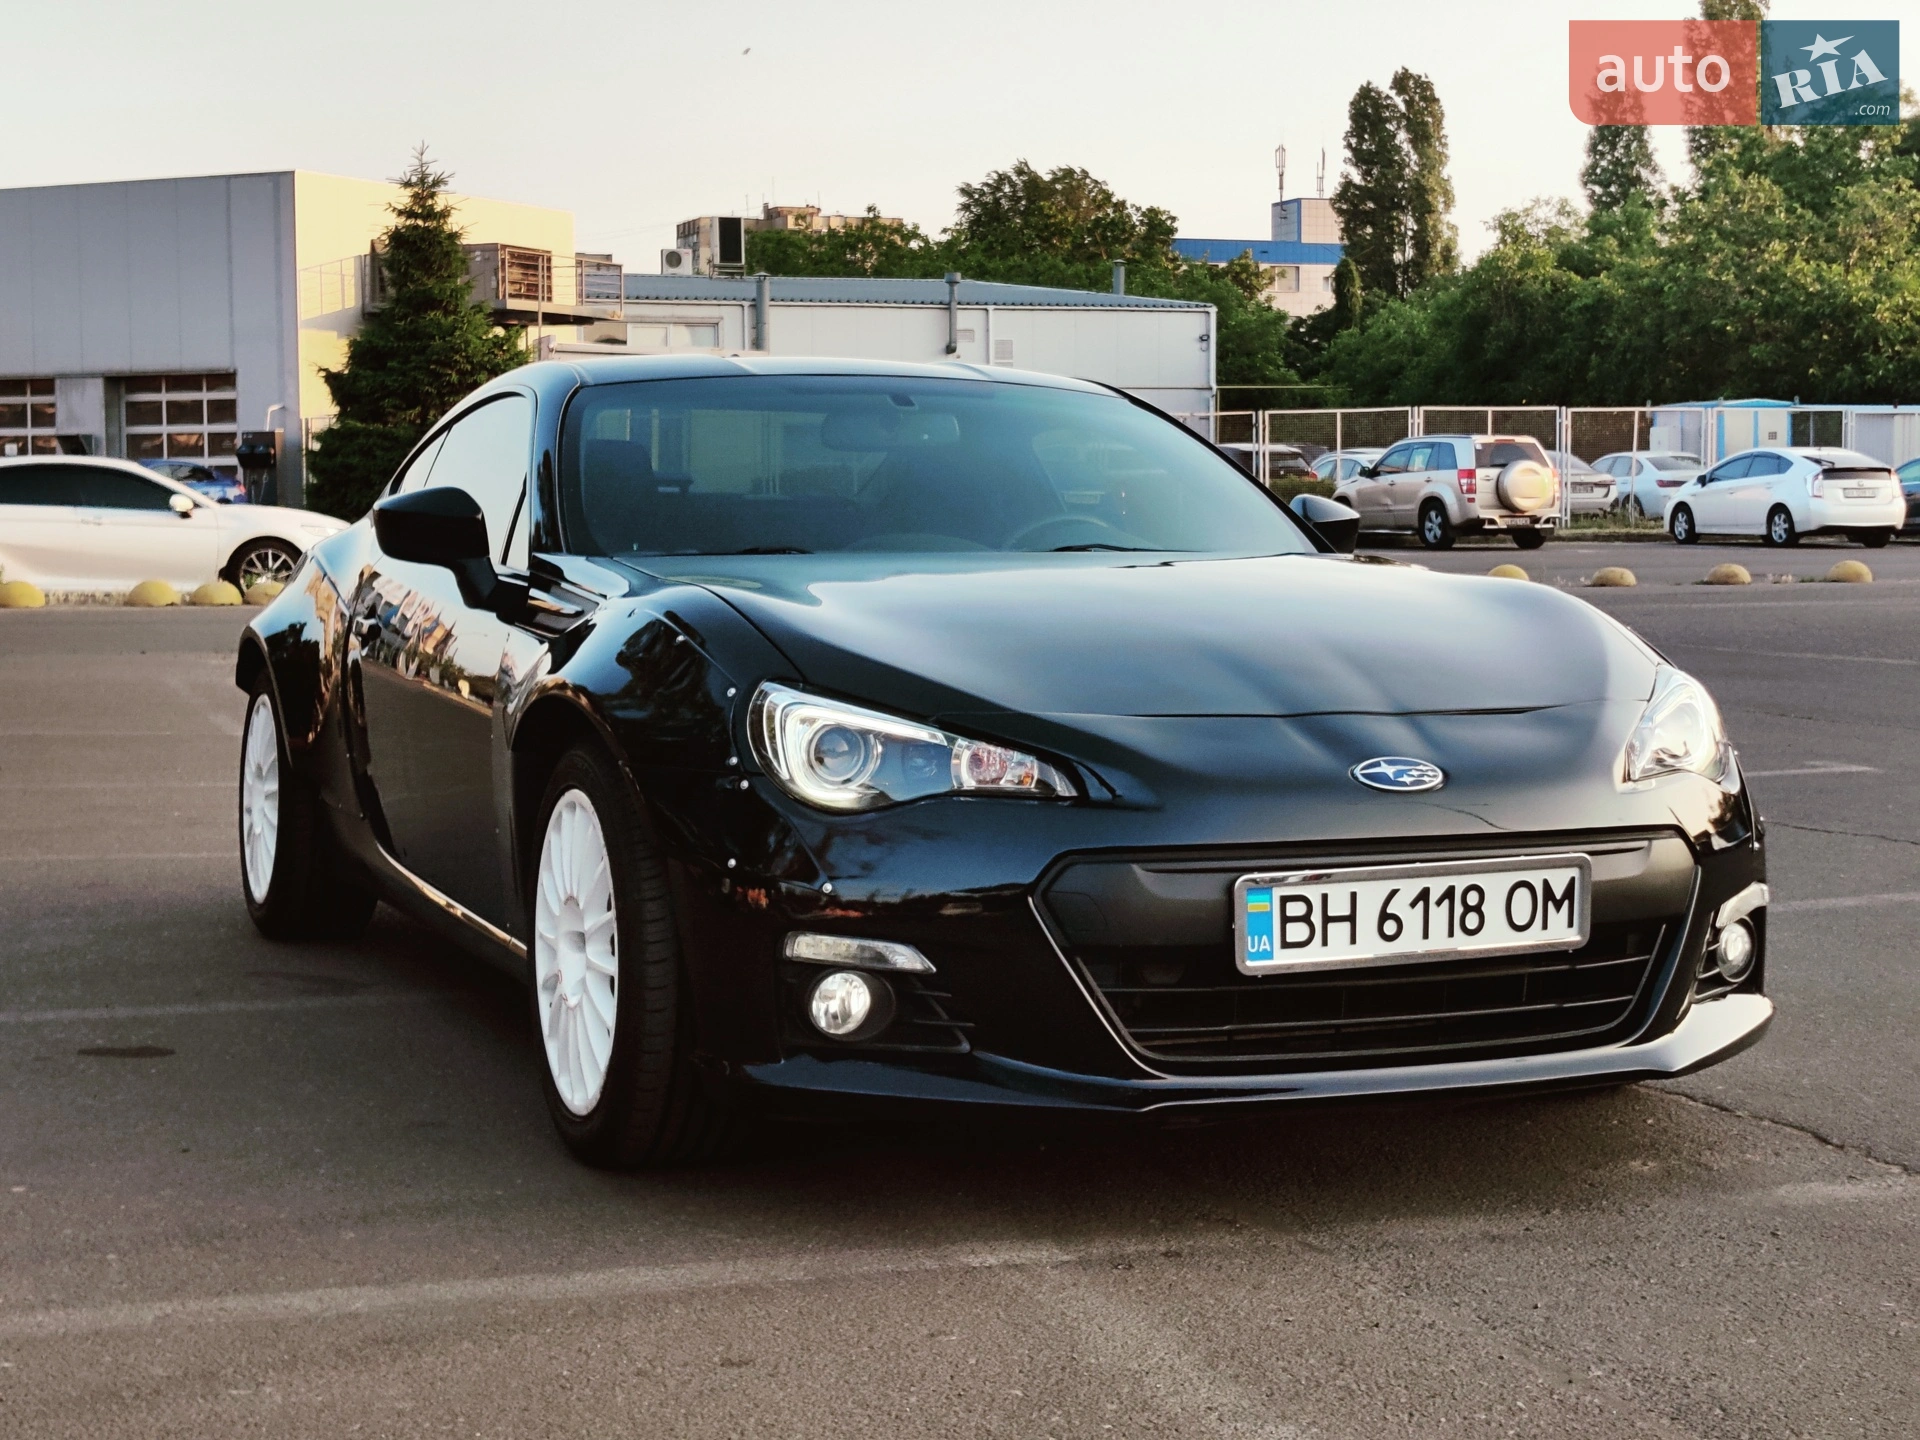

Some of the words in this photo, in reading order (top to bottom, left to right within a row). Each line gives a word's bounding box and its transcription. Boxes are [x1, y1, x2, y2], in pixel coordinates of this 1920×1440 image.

[1279, 891, 1357, 949] BH
[1377, 883, 1486, 942] 6118
[1505, 876, 1576, 932] OM
[1247, 935, 1271, 953] UA
